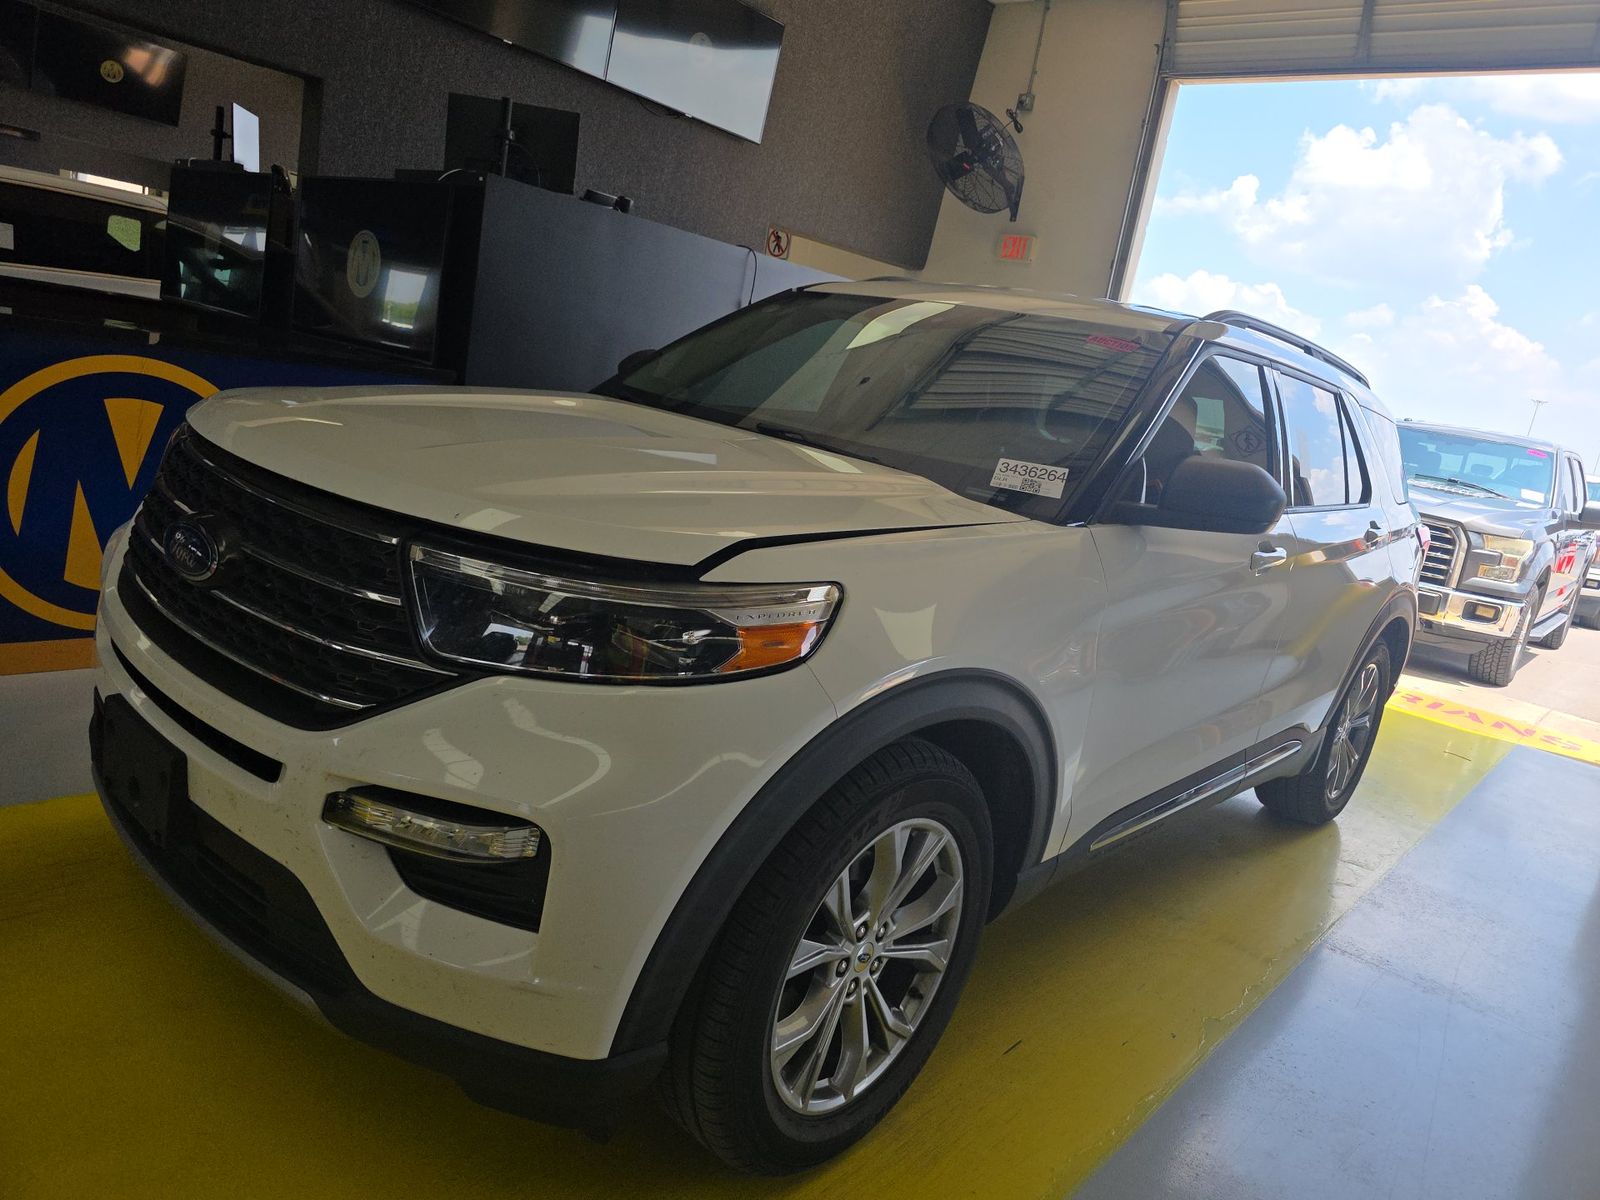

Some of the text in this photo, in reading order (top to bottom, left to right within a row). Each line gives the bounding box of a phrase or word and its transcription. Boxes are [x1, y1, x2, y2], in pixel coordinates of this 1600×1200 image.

[1001, 235, 1031, 259] EXIT
[999, 461, 1067, 483] 3436264
[735, 608, 816, 621] EXPLORER
